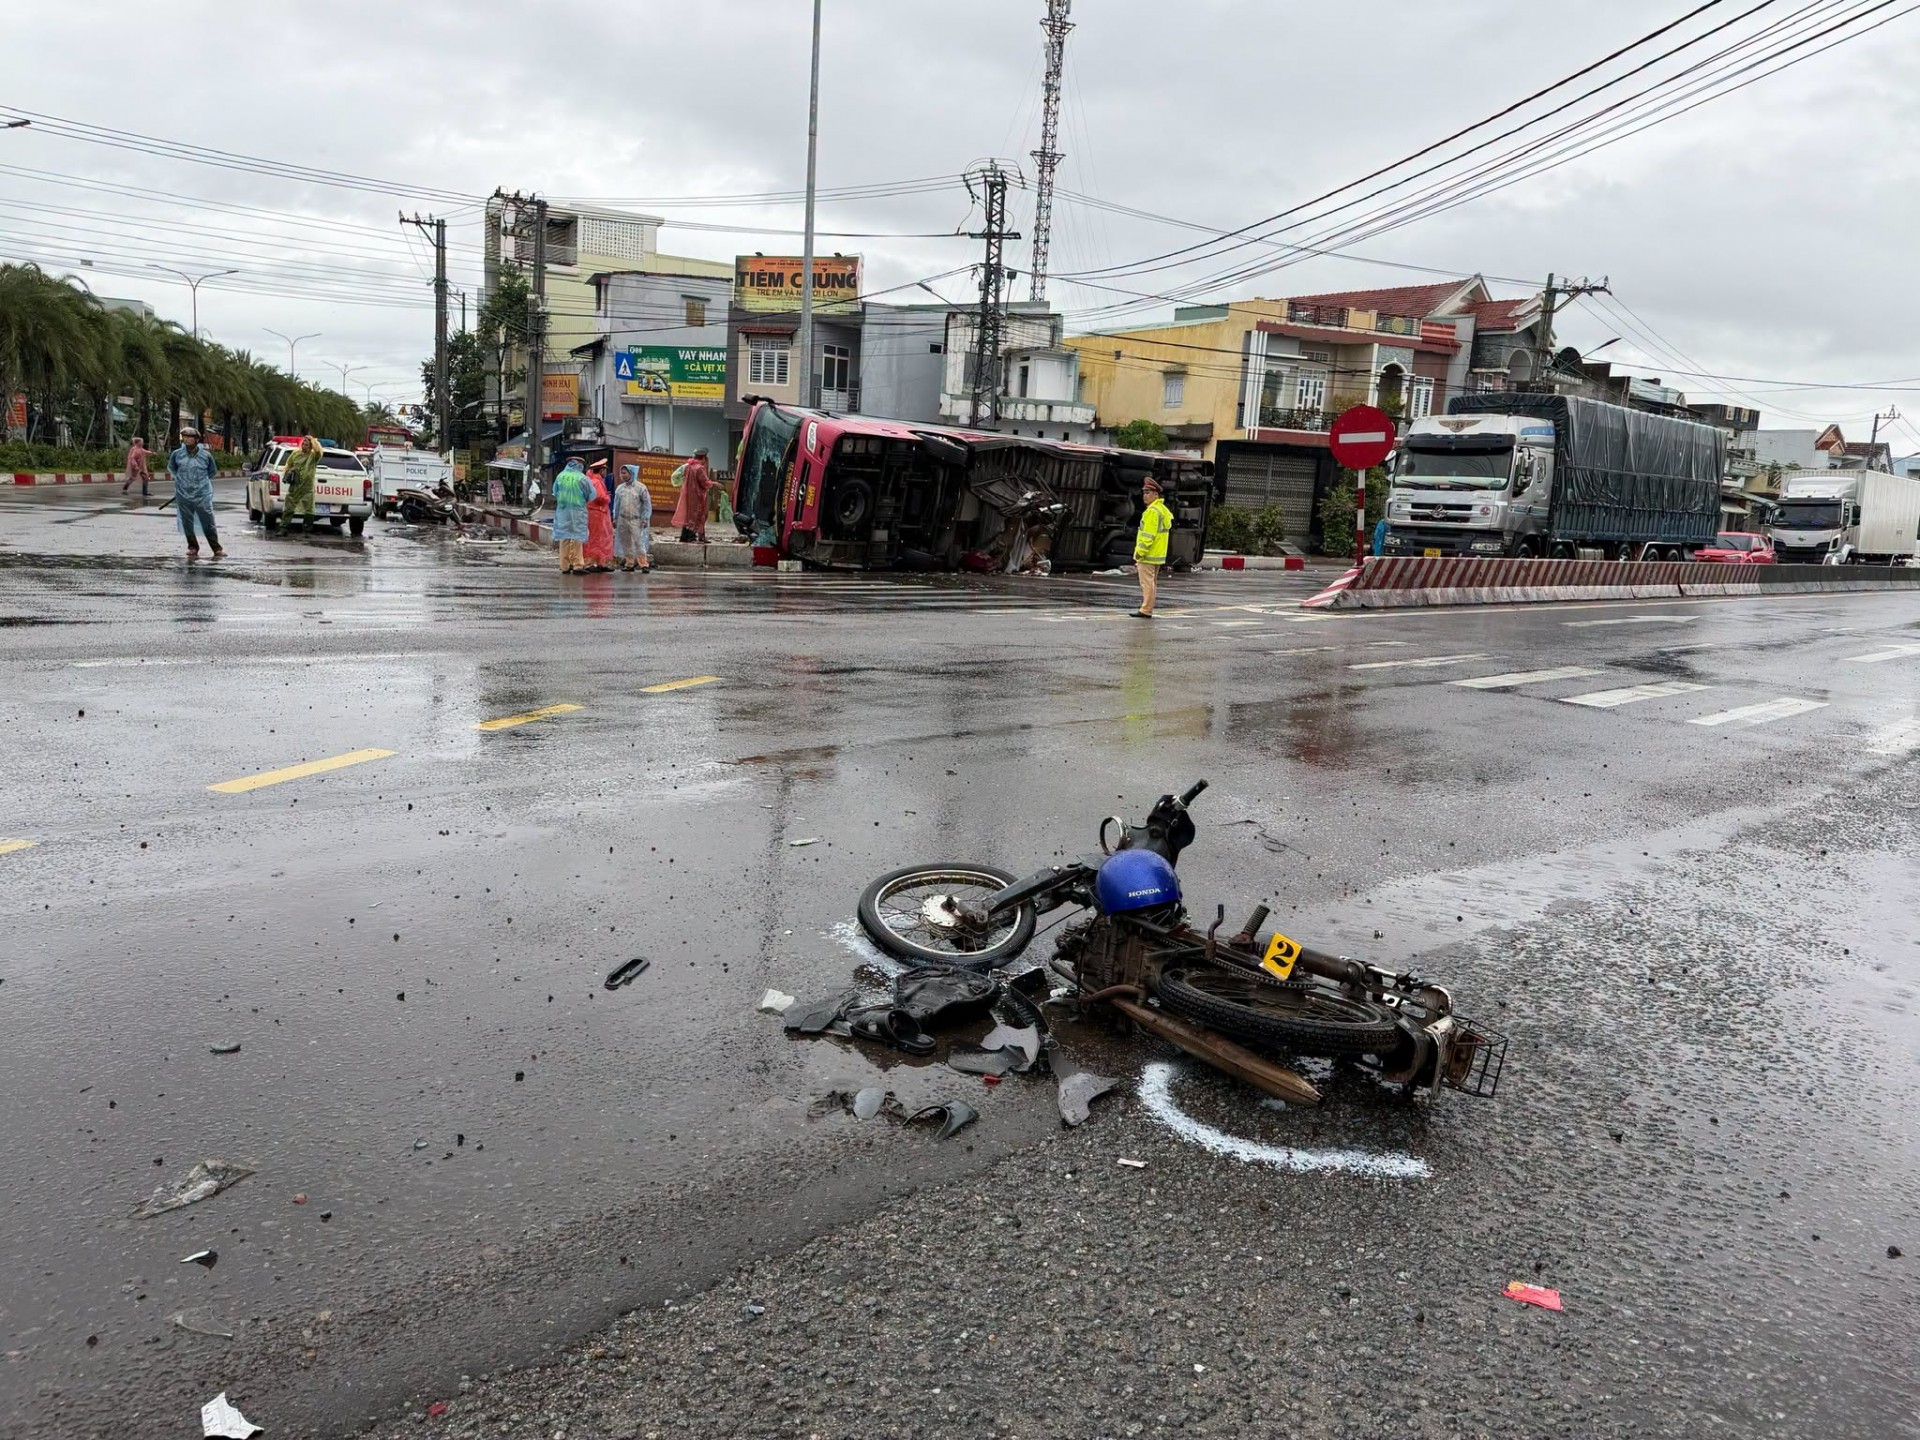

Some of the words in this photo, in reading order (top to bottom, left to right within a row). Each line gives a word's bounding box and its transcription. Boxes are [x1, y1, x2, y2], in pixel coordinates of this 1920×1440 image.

[678, 350, 697, 360] VAY
[716, 364, 727, 372] XE
[406, 467, 427, 476] POLICE
[314, 485, 353, 496] UBISHI
[1128, 887, 1161, 898] HONDA
[1269, 940, 1295, 968] 2
